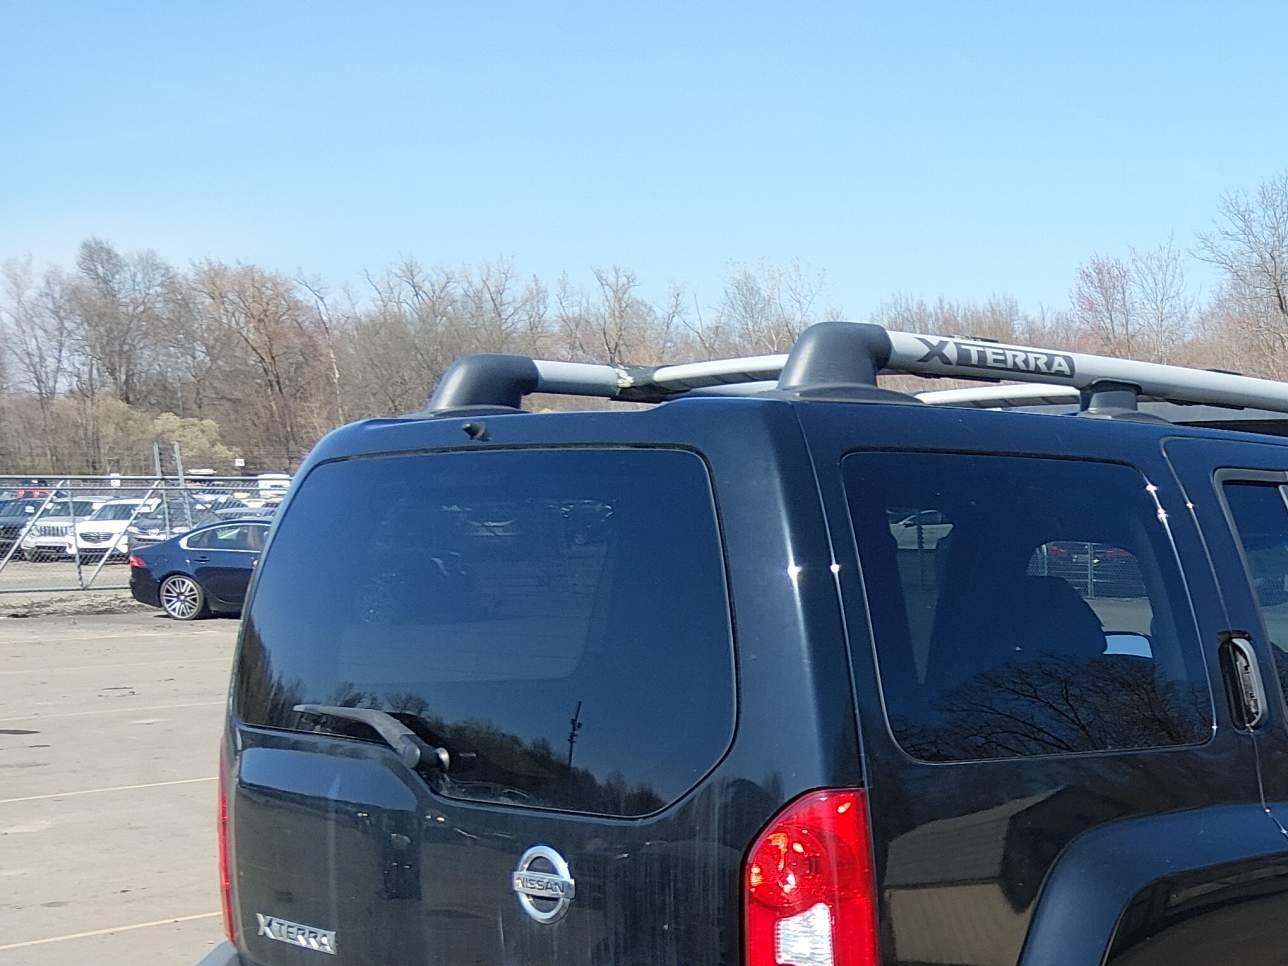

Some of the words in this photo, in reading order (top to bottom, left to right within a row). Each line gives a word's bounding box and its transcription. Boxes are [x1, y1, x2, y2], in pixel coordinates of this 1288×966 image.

[914, 336, 1074, 377] XTERRA
[516, 877, 566, 894] NISSAN
[256, 912, 337, 955] XTERRA
